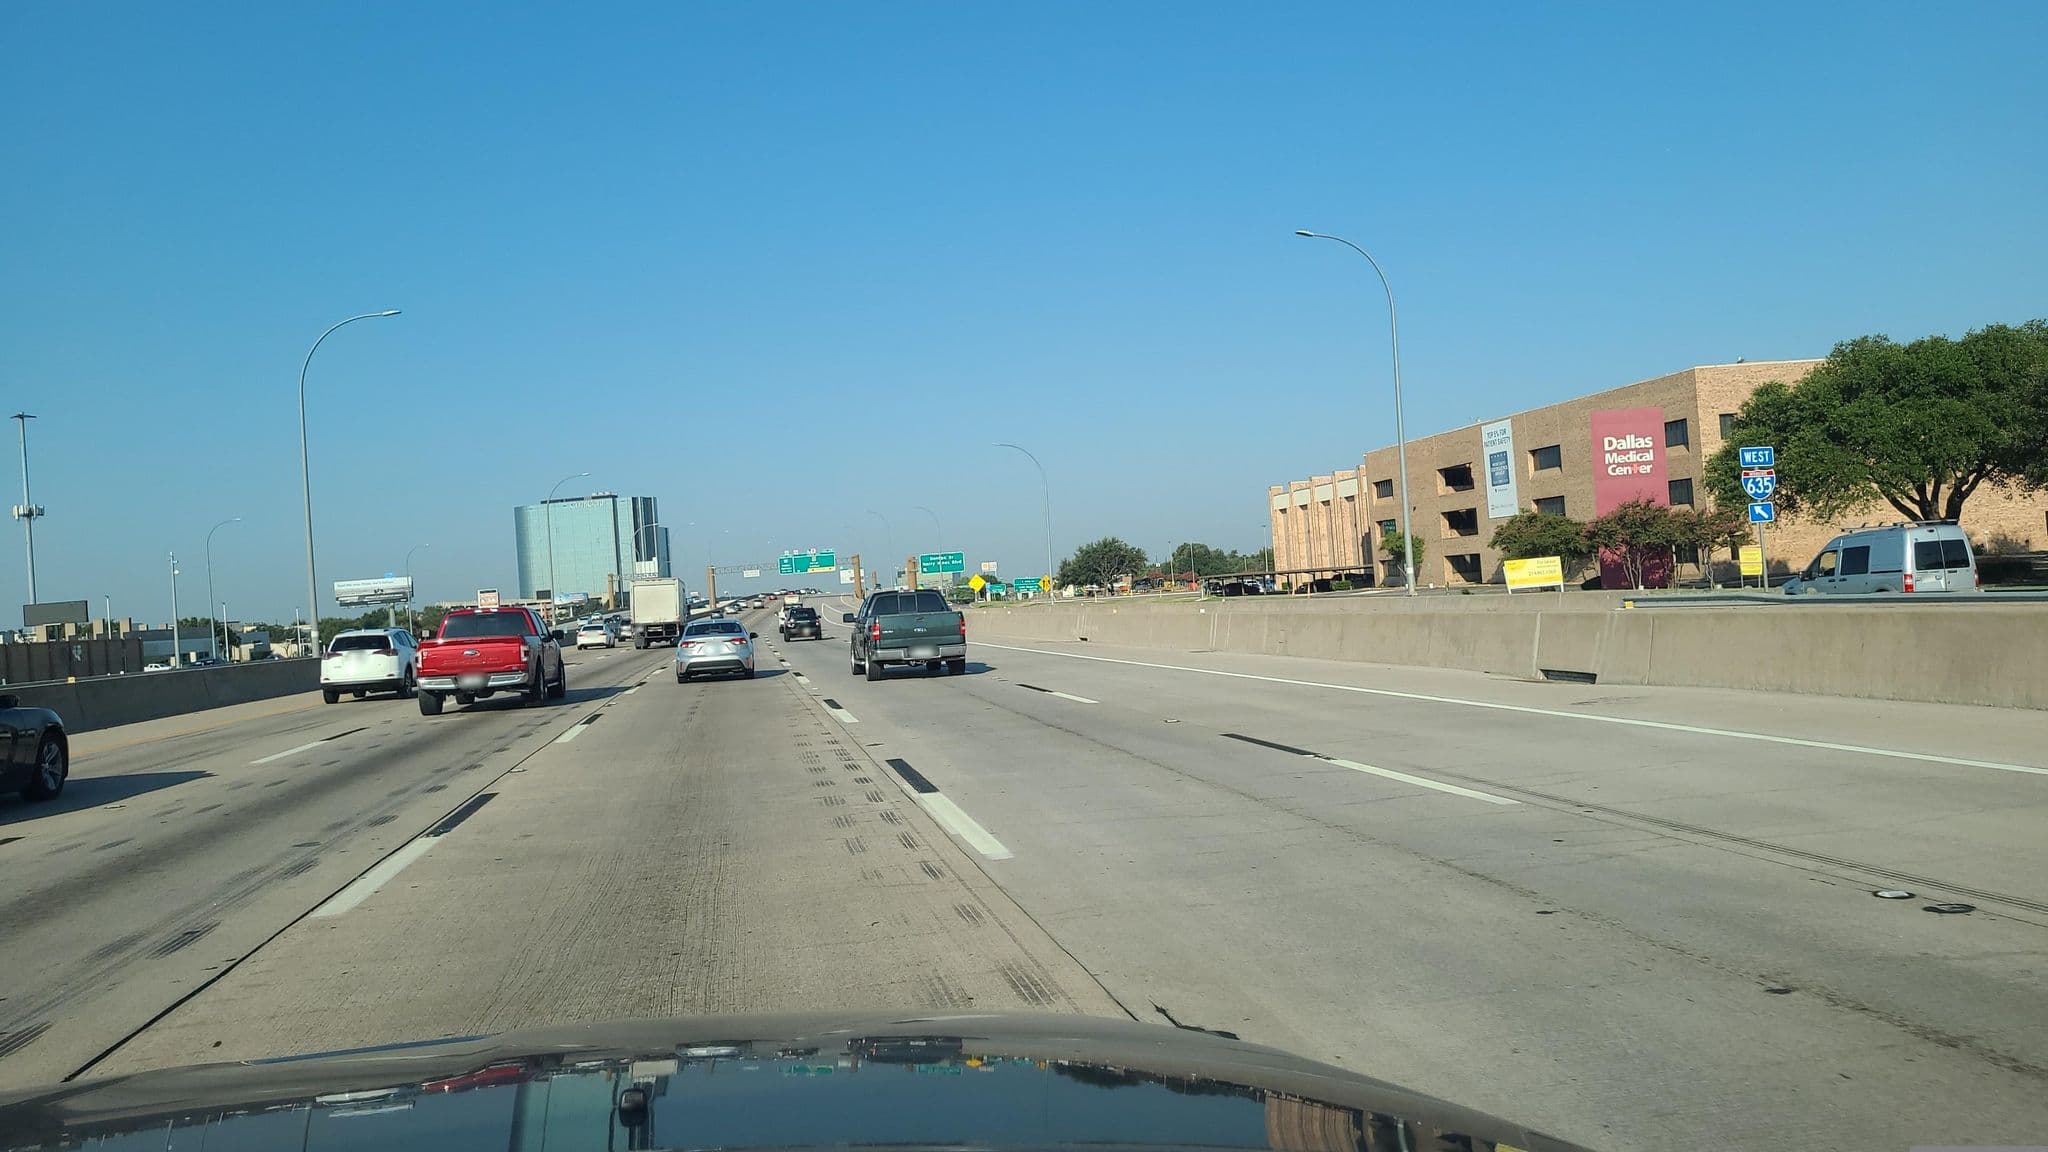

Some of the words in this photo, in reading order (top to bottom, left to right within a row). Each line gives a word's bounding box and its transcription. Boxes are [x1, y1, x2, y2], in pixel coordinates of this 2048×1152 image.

[1603, 434, 1653, 451] Dallas
[1605, 449, 1654, 465] Medical
[1743, 451, 1769, 462] WEST
[1607, 463, 1653, 476] Center
[1747, 477, 1772, 494] 635
